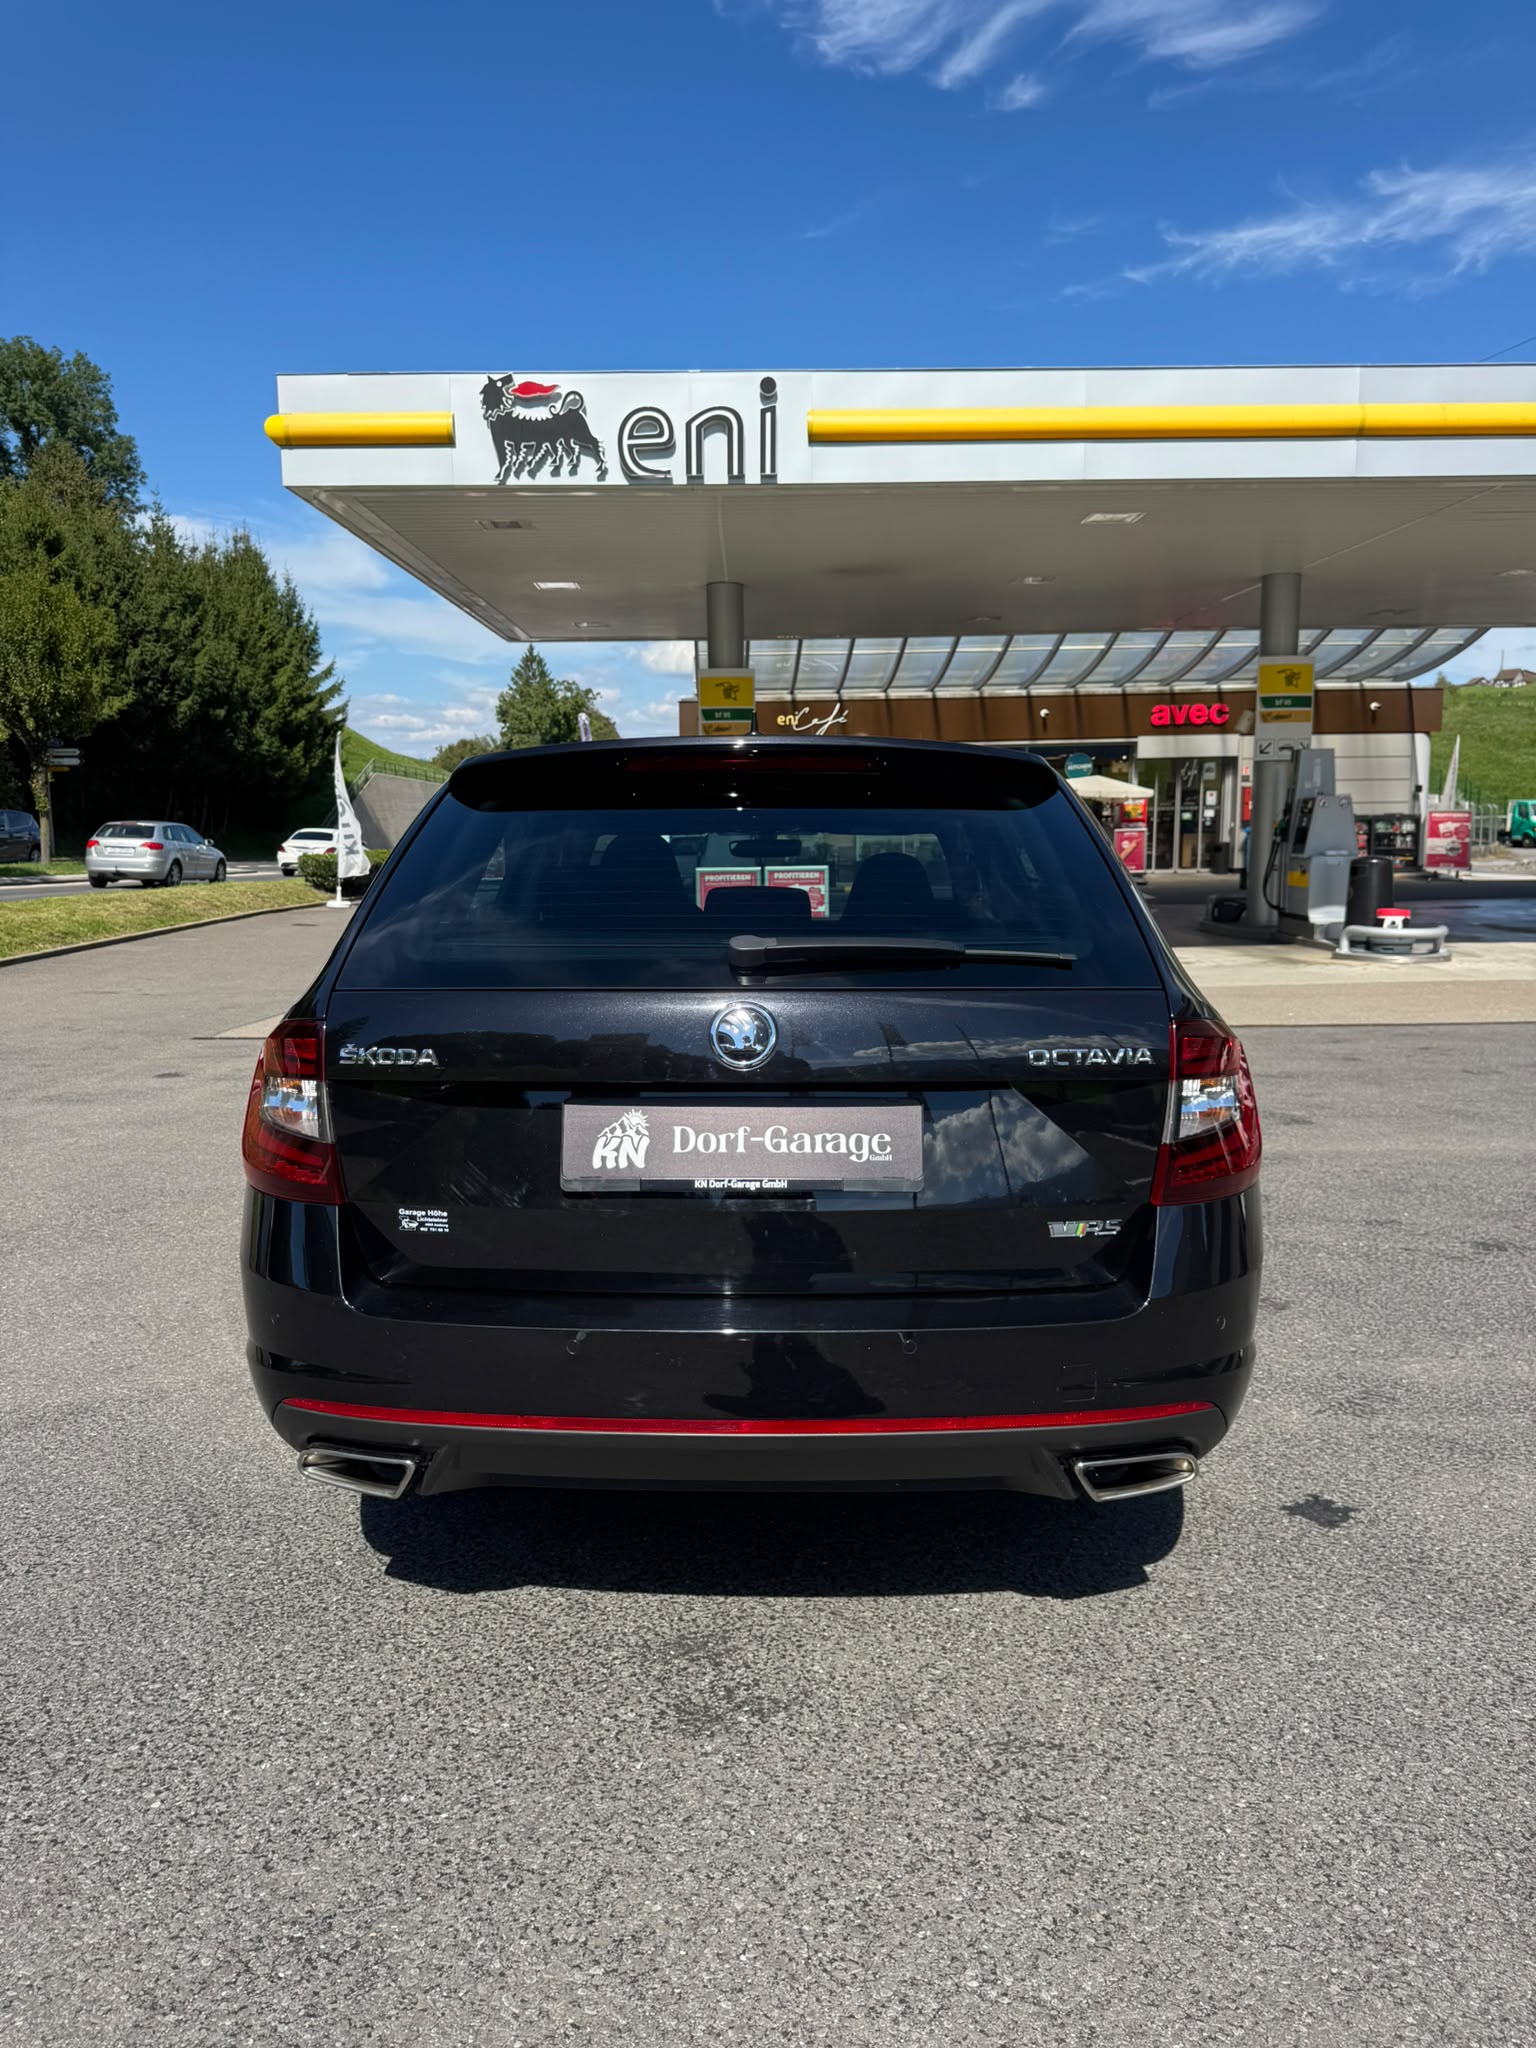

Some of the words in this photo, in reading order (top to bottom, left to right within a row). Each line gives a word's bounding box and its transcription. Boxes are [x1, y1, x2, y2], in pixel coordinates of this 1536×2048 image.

[617, 376, 779, 479] eni
[1150, 703, 1230, 726] avec
[704, 874, 752, 882] PROFITIEREN
[773, 872, 820, 880] PROFITIEREN
[339, 1043, 439, 1066] ŠKODA
[1028, 1047, 1156, 1067] OCTAVIA
[592, 1134, 651, 1170] KN
[672, 1125, 892, 1163] Dorf-Garage
[869, 1153, 893, 1161] GmbH
[694, 1179, 708, 1188] KN
[709, 1179, 761, 1191] Dorf-Garage
[762, 1179, 788, 1189] GmbH
[398, 1208, 426, 1217] Garage
[427, 1209, 448, 1217] Höhe
